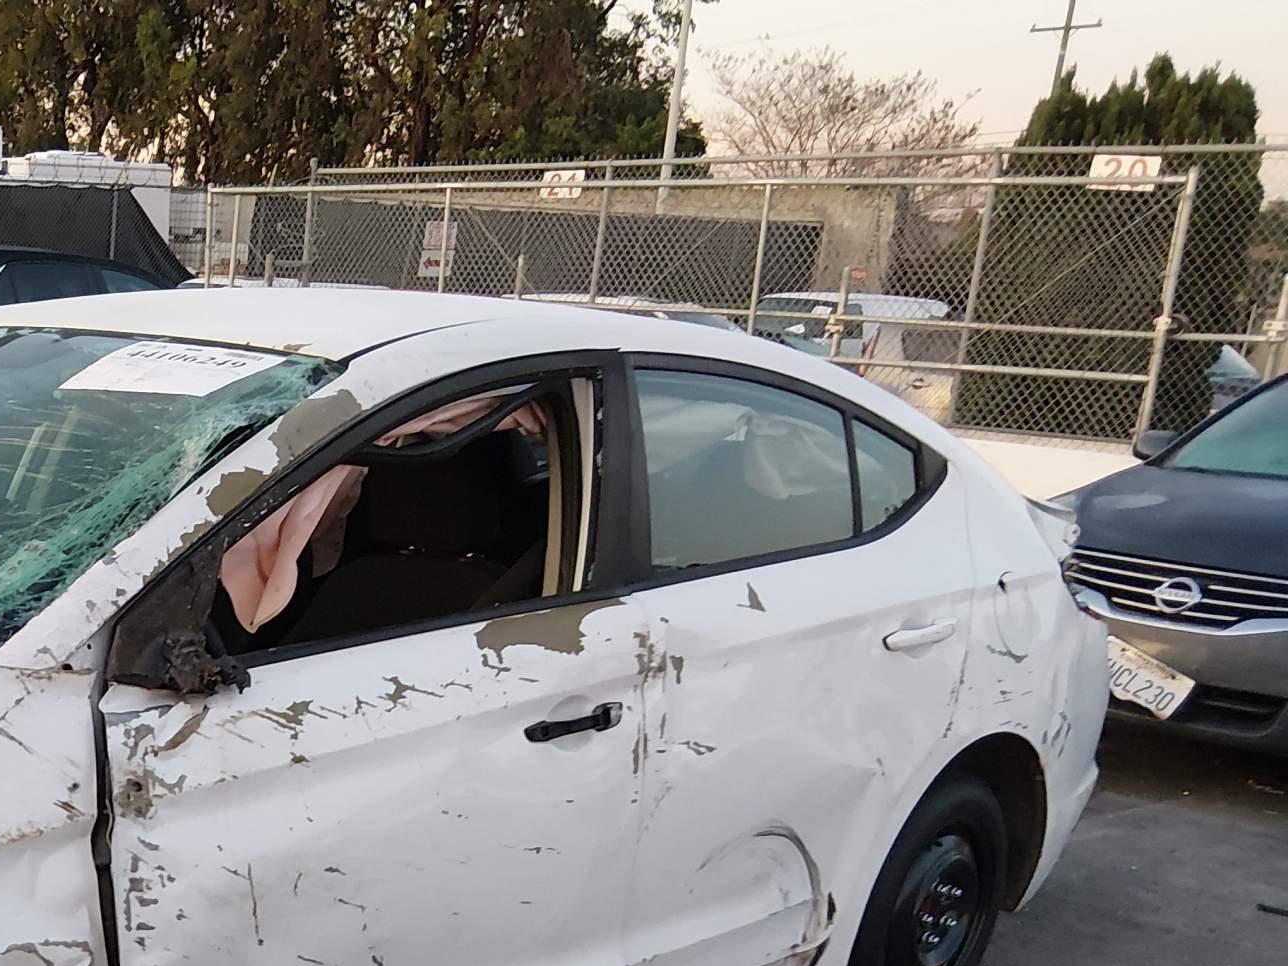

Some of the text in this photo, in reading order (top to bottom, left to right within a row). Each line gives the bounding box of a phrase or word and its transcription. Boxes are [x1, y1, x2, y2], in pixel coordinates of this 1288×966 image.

[1103, 156, 1148, 189] 20
[125, 349, 248, 369] 44106249
[1107, 658, 1176, 711] CL230
